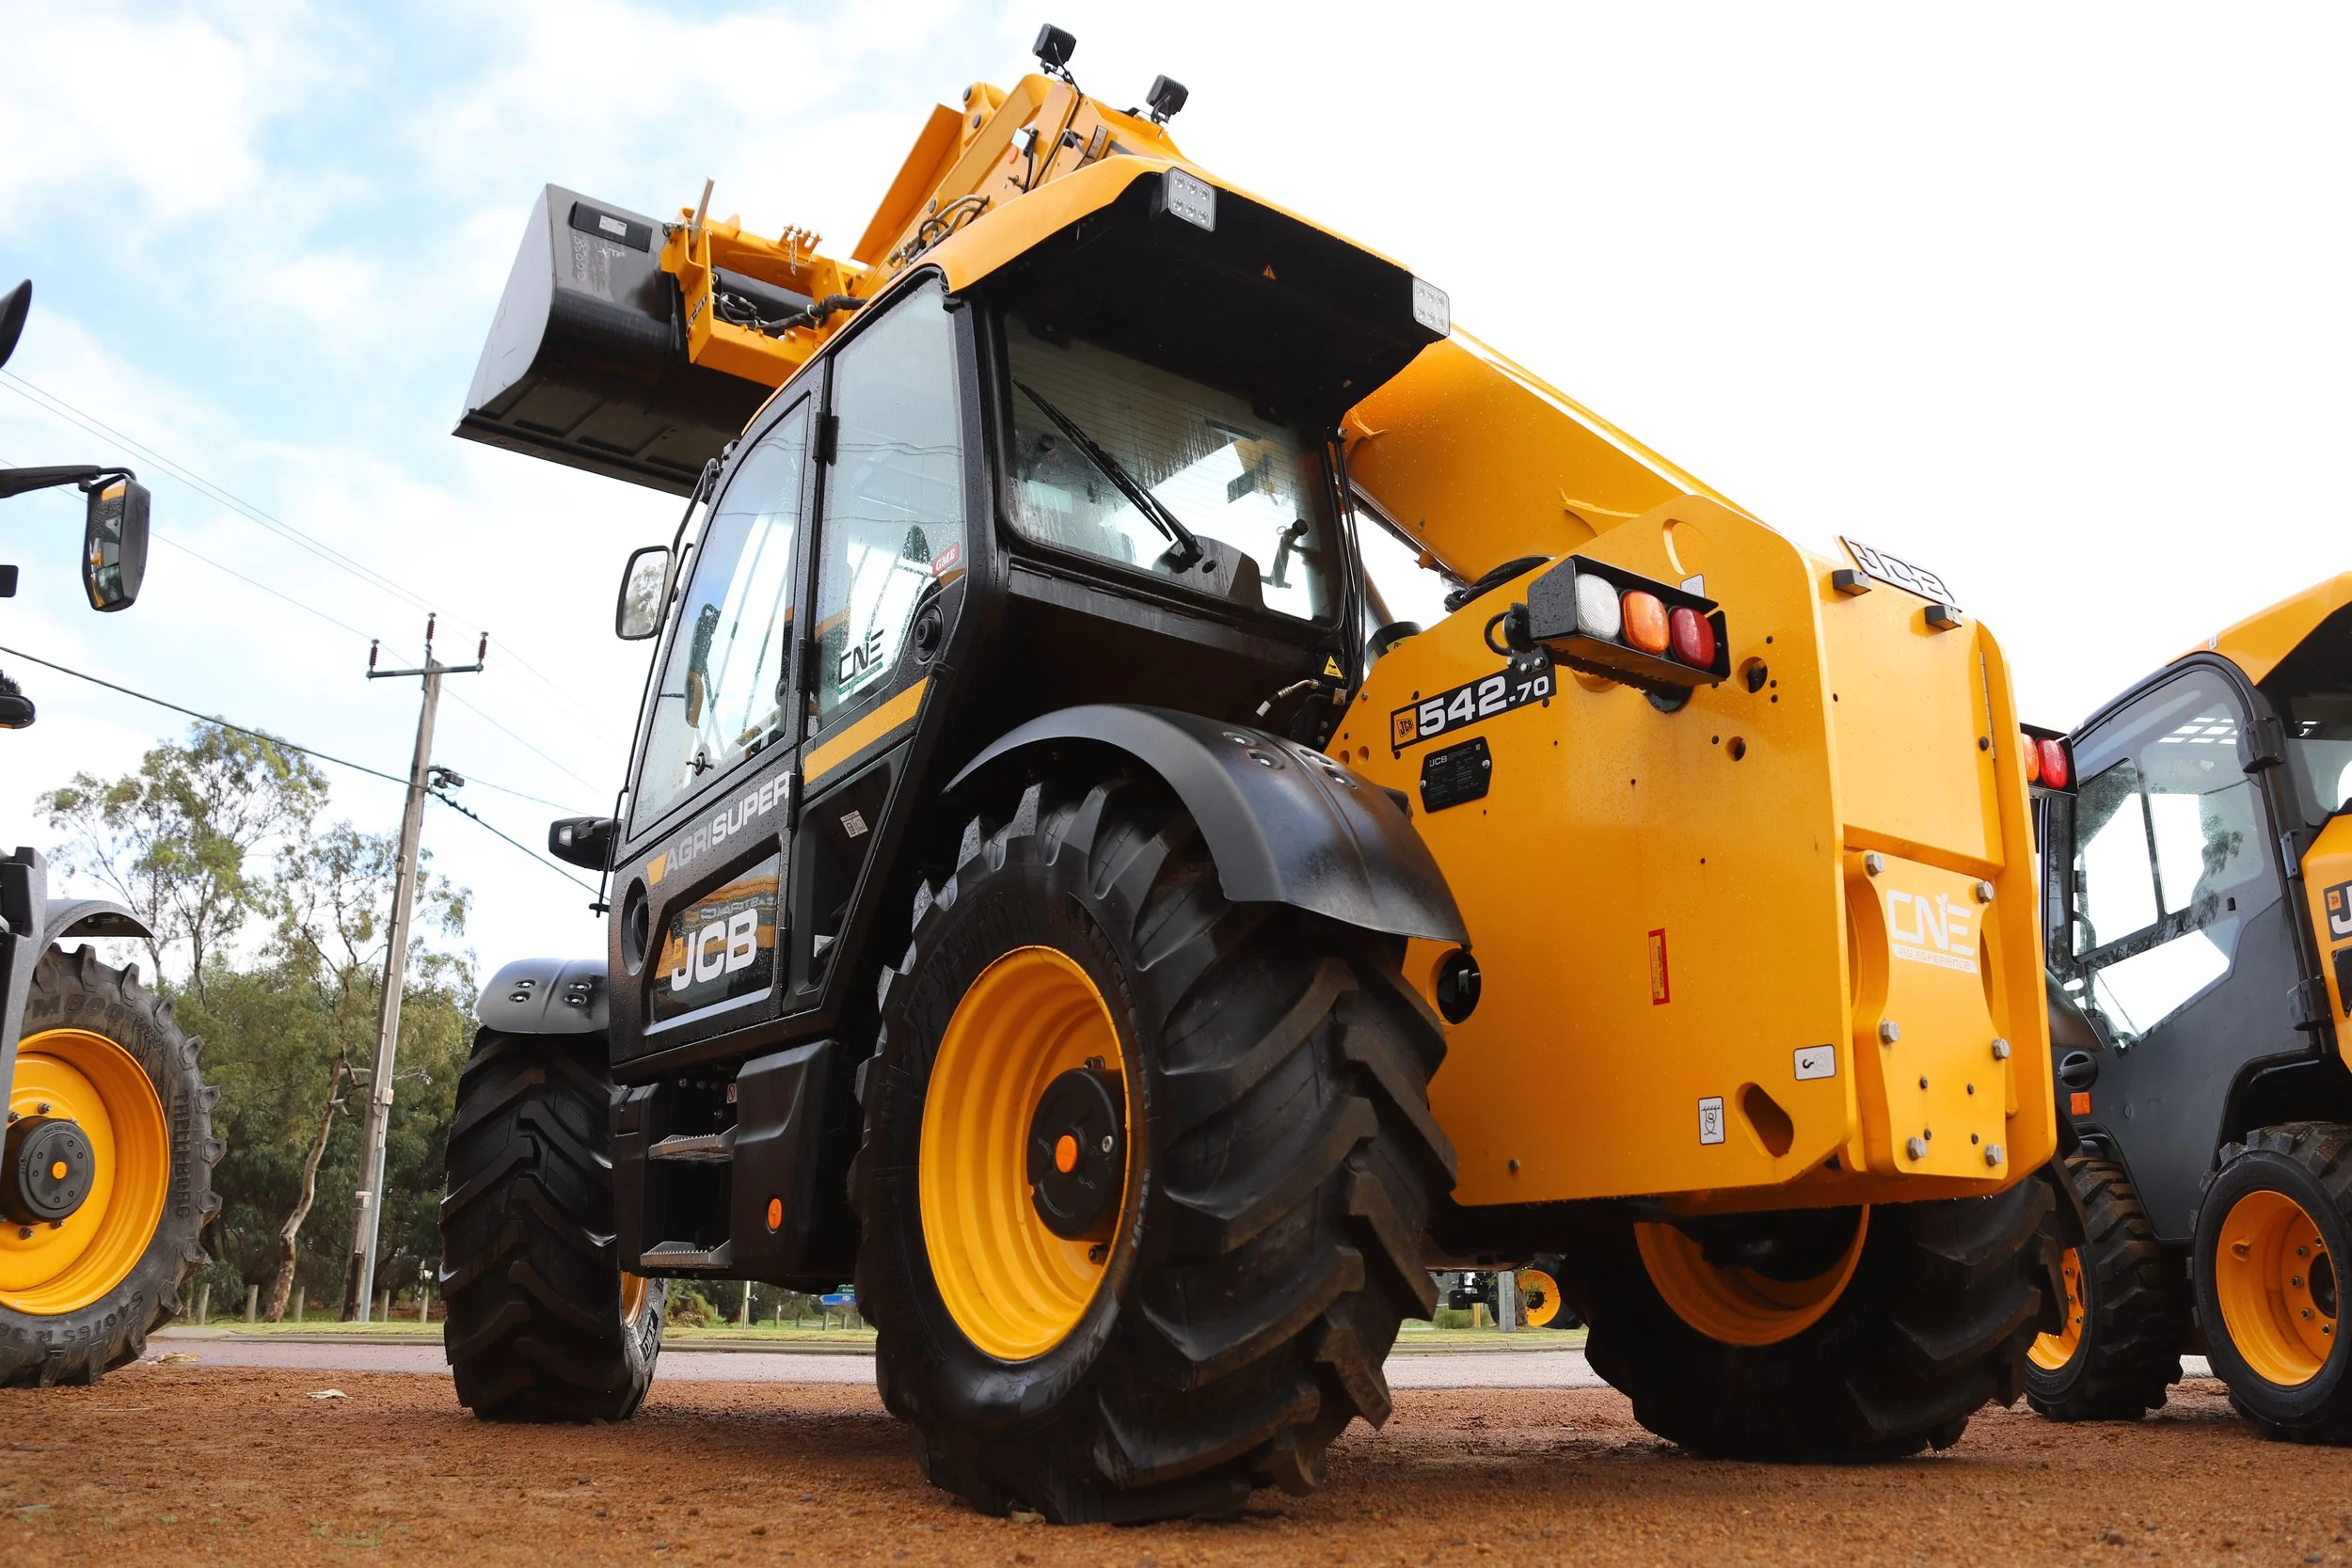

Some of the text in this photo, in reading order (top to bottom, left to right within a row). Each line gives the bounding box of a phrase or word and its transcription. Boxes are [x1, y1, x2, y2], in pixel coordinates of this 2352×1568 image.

[935, 546, 956, 572] GME
[1848, 540, 1956, 604] JCB
[1398, 718, 1414, 736] JCB
[1419, 674, 1550, 736] 542-70
[1429, 754, 1448, 768] JCB
[662, 769, 790, 879] AGRISUPER
[671, 907, 758, 992] JCB
[1899, 946, 1972, 971] AG ESPERANCE
